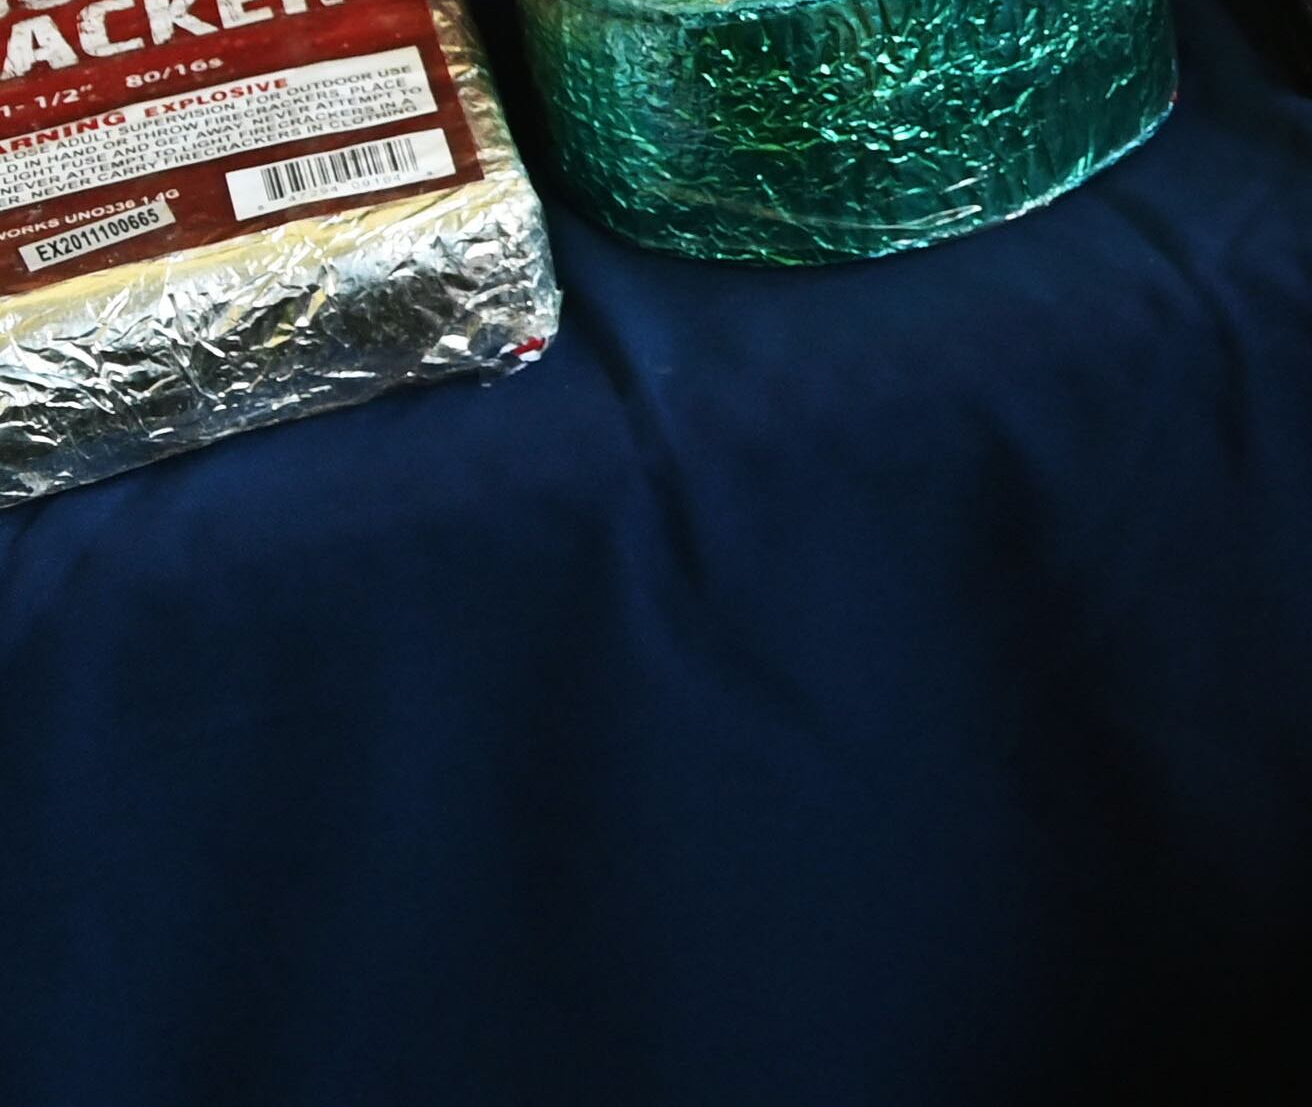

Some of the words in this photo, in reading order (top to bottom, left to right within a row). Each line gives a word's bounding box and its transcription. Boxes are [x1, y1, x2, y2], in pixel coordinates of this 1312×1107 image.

[55, 129, 112, 151] ADULT
[244, 90, 284, 109] FOR
[285, 69, 374, 99] OUTDOOR
[376, 63, 412, 80] USE
[124, 54, 224, 88] 80/16s
[0, 110, 128, 155] RNING
[142, 76, 289, 119] EXPLOSIVE
[2, 166, 55, 185] LIGHT
[60, 152, 110, 172] FUSE
[113, 141, 153, 159] AND
[154, 132, 190, 149] GET
[247, 103, 312, 128] NEVER
[314, 86, 395, 116] ATTEMPT
[45, 144, 99, 165] HAND
[101, 136, 130, 151] OR
[131, 119, 201, 145] THROW
[349, 76, 408, 98] PLACE
[64, 154, 150, 181] ATTEMPT
[153, 146, 180, 160] TO
[181, 133, 233, 153] LIGHT
[236, 100, 375, 142] FIRECRACKERS
[30, 176, 92, 199] NEVER
[96, 159, 158, 183] CARRY
[162, 125, 303, 167] FIRECRACKERS
[32, 208, 164, 265] EX2011100665
